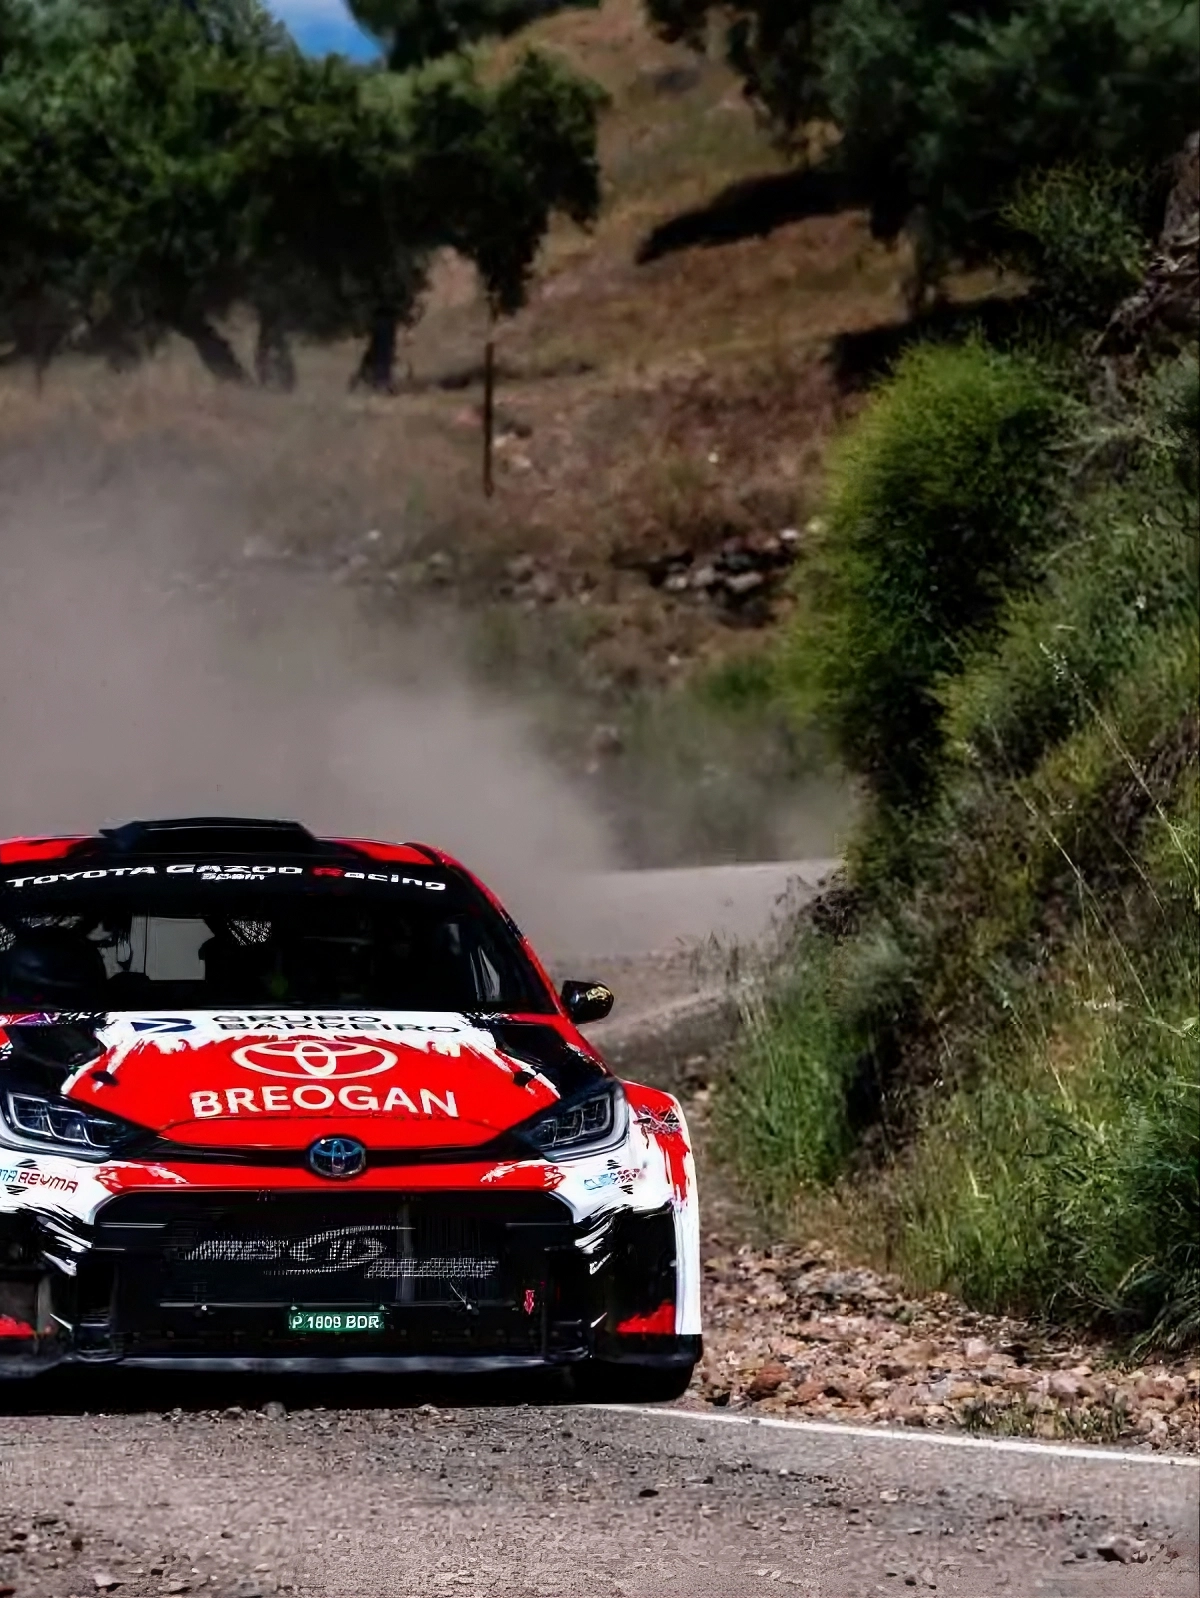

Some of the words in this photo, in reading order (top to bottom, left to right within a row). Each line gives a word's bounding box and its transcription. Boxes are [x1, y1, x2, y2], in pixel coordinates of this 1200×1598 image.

[6, 866, 156, 888] TOYOTA
[166, 864, 302, 874] GAZOO
[312, 866, 446, 891] Racing
[189, 1085, 459, 1118] BREOGAN
[307, 1315, 342, 1329] 1809
[345, 1315, 380, 1329] BDR
